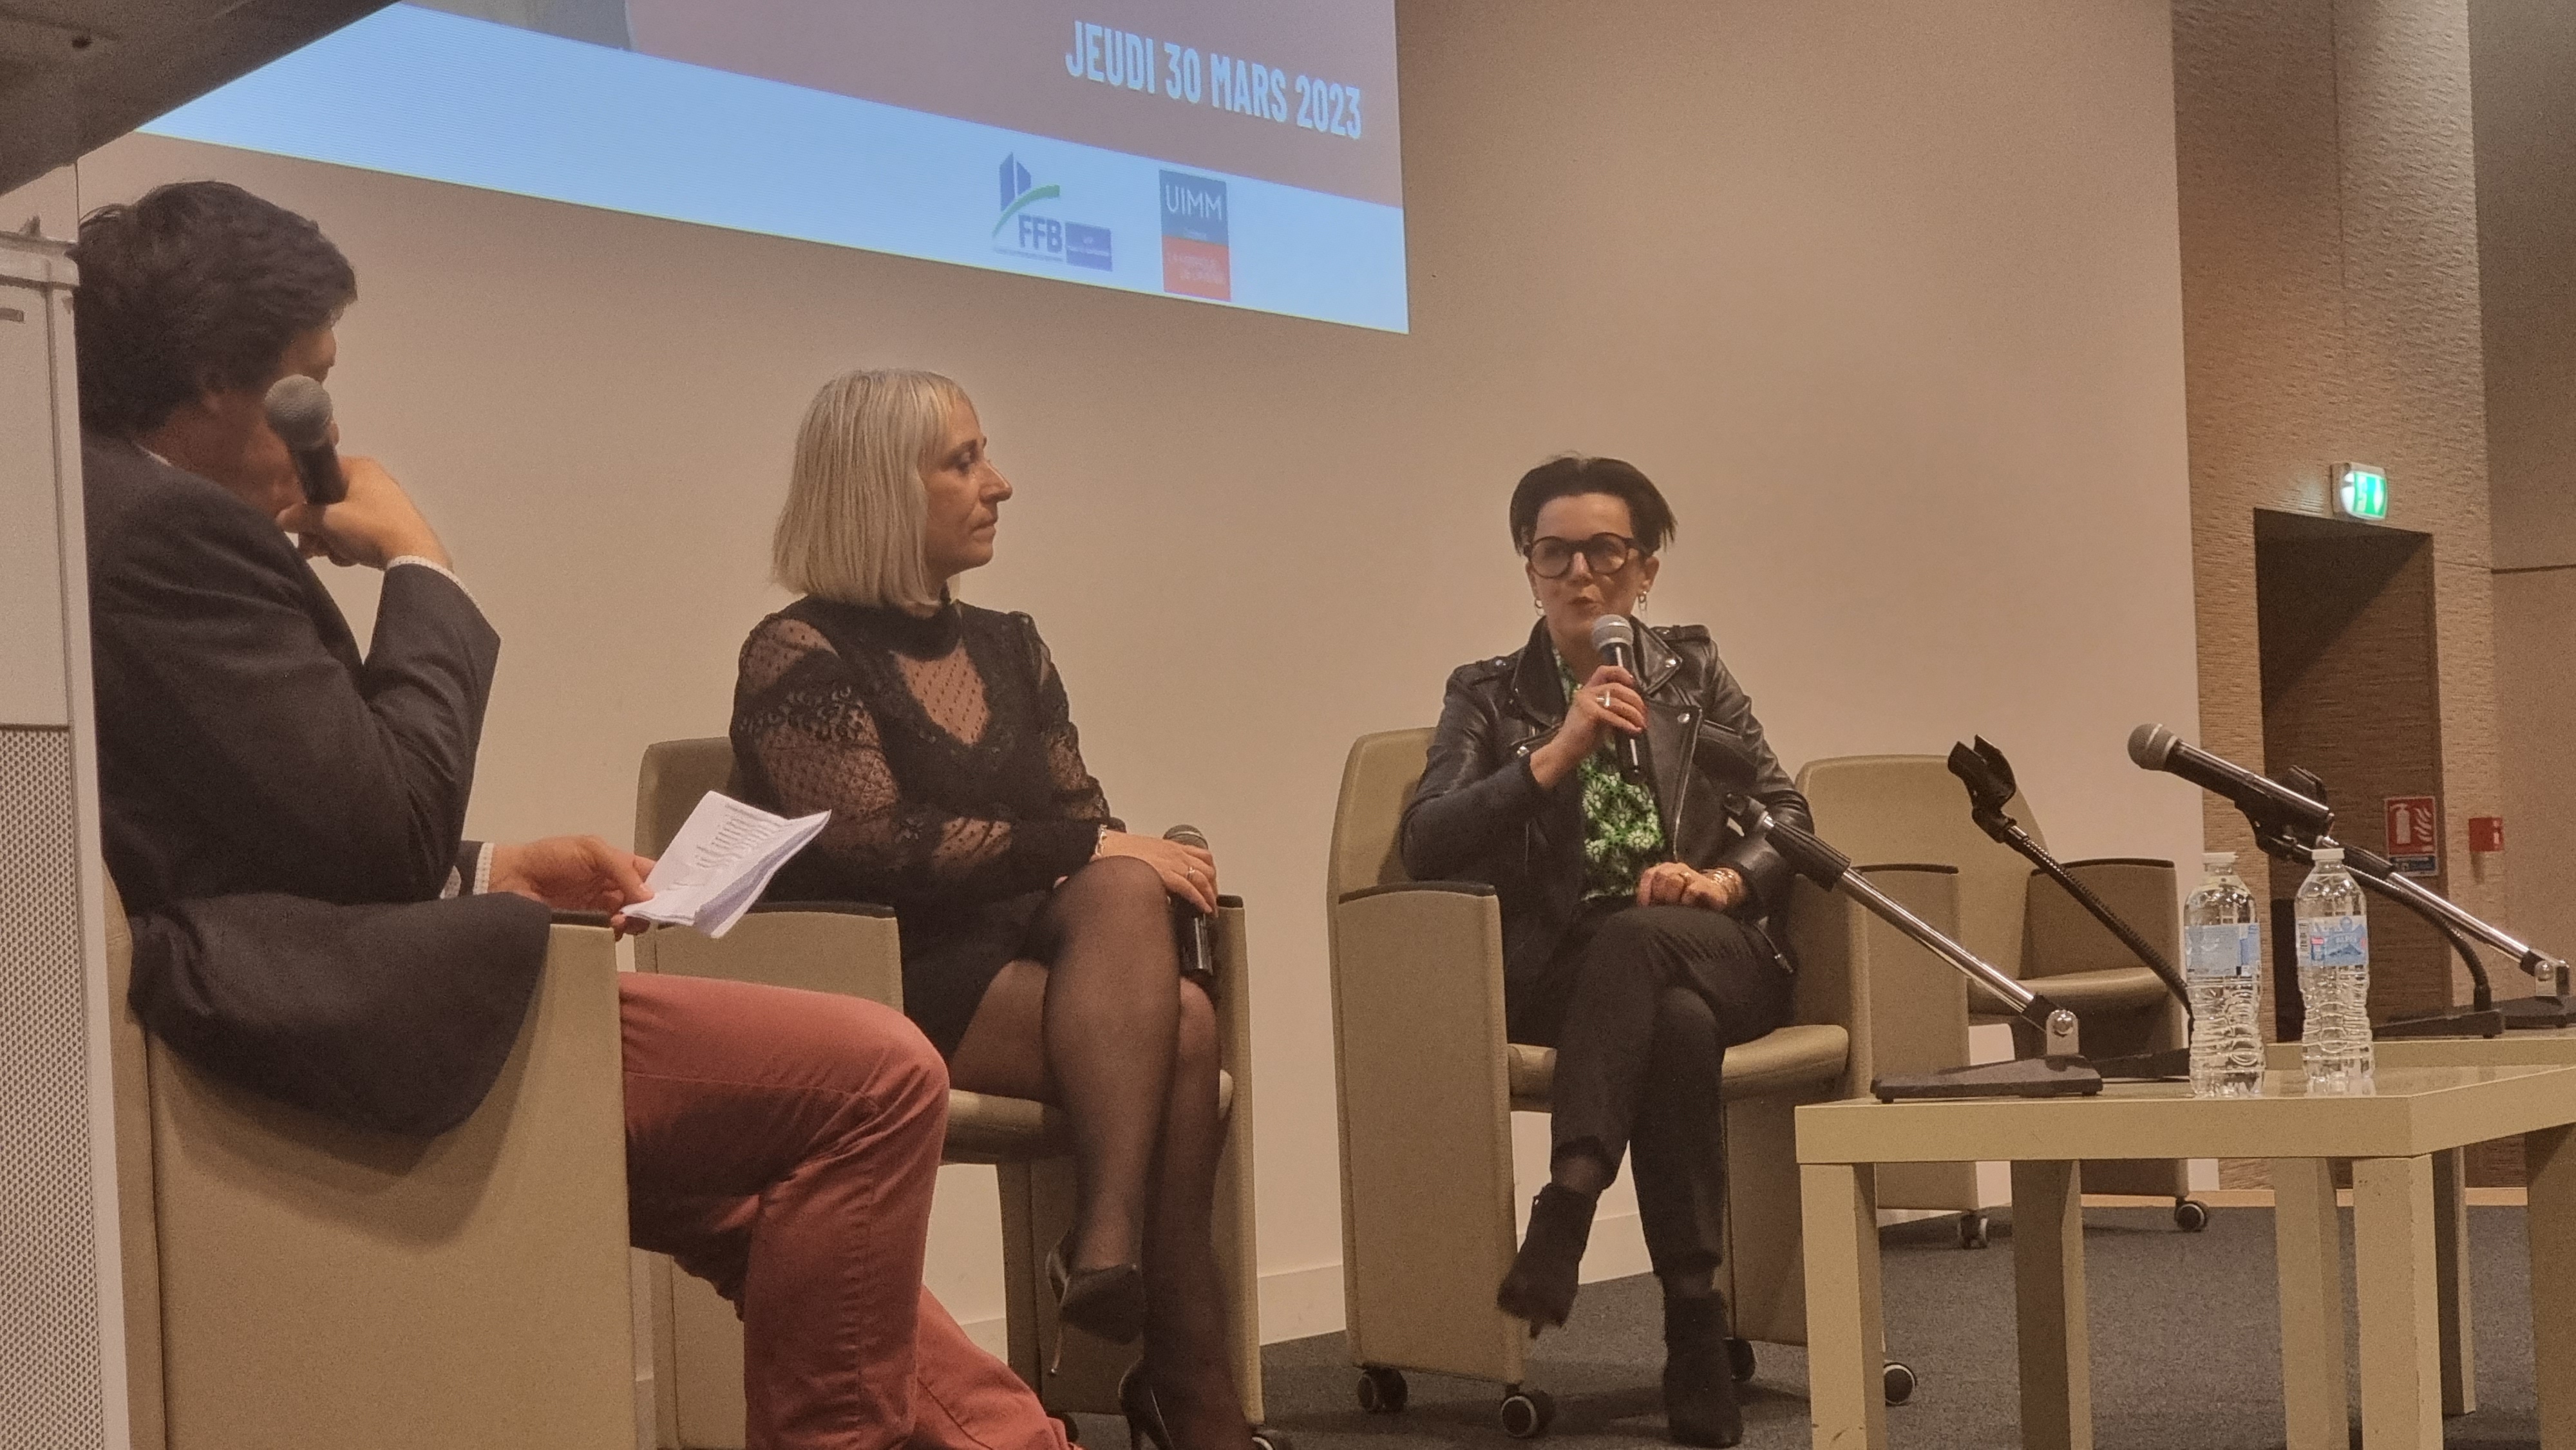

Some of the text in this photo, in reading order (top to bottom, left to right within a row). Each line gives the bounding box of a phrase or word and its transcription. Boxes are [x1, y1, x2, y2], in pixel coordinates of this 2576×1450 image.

[1065, 21, 1363, 140] JEUDI 30 MARS 2023
[1166, 184, 1222, 220] UIMM
[1018, 214, 1063, 254] FFB
